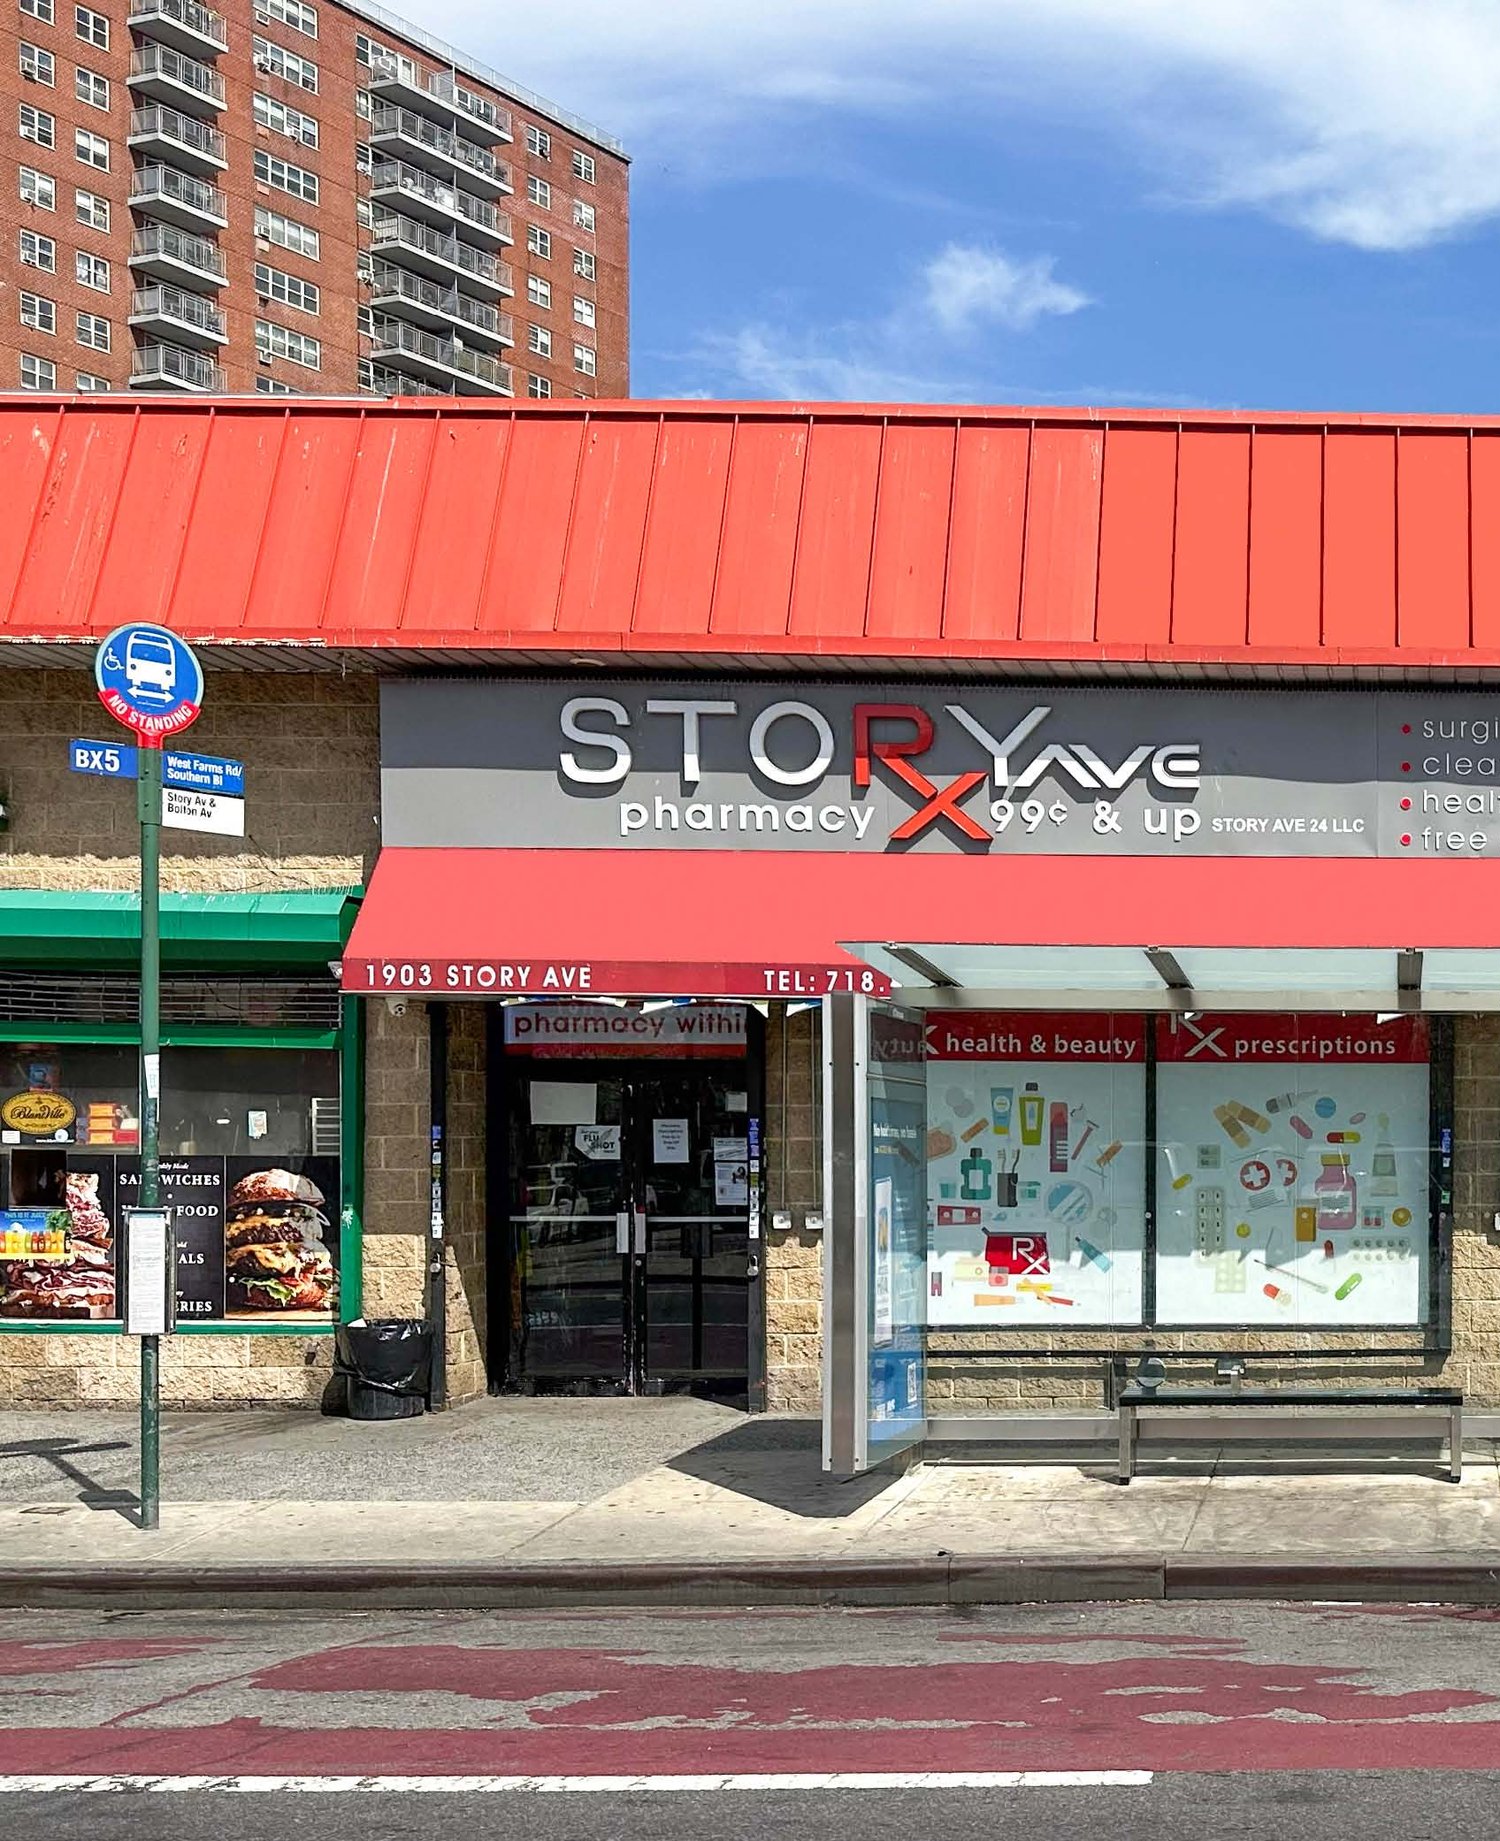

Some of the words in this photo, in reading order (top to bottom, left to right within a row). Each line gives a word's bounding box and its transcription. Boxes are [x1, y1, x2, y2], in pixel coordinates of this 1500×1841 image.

[109, 694, 127, 715] NO
[128, 704, 193, 731] STANDING
[75, 748, 120, 773] BX5
[167, 756, 191, 768] West
[193, 757, 223, 773] Farms
[225, 765, 243, 777] Rd/
[167, 769, 211, 784] Southern
[168, 792, 192, 806] Story
[195, 797, 207, 806] Av
[209, 798, 217, 808] &
[168, 802, 198, 816] Bolton
[200, 807, 212, 818] Av
[620, 796, 875, 840] pharmacy
[990, 799, 1068, 835] 99¢
[1092, 800, 1124, 835] &
[1144, 807, 1201, 842] up
[1212, 817, 1267, 833] STORY
[1272, 818, 1305, 833] AVE
[1309, 818, 1328, 833] 24
[1332, 818, 1364, 833] LLC
[1421, 827, 1488, 852] free
[366, 964, 432, 987] 1903
[446, 965, 531, 988] STORY
[542, 965, 591, 989] AVE
[763, 970, 815, 993] TEL:
[826, 970, 902, 993] 718.
[514, 1012, 664, 1038] pharmacy
[676, 1012, 747, 1034] withi
[946, 1032, 1022, 1054] health
[1030, 1034, 1047, 1054] &
[1055, 1034, 1136, 1060] beauty
[1235, 1035, 1395, 1059] prescriptions
[583, 1134, 599, 1142] FLU
[591, 1141, 615, 1149] SHOT
[119, 1173, 220, 1186] SAWICHES
[176, 1205, 219, 1217] FOOD
[178, 1253, 205, 1264] ALS
